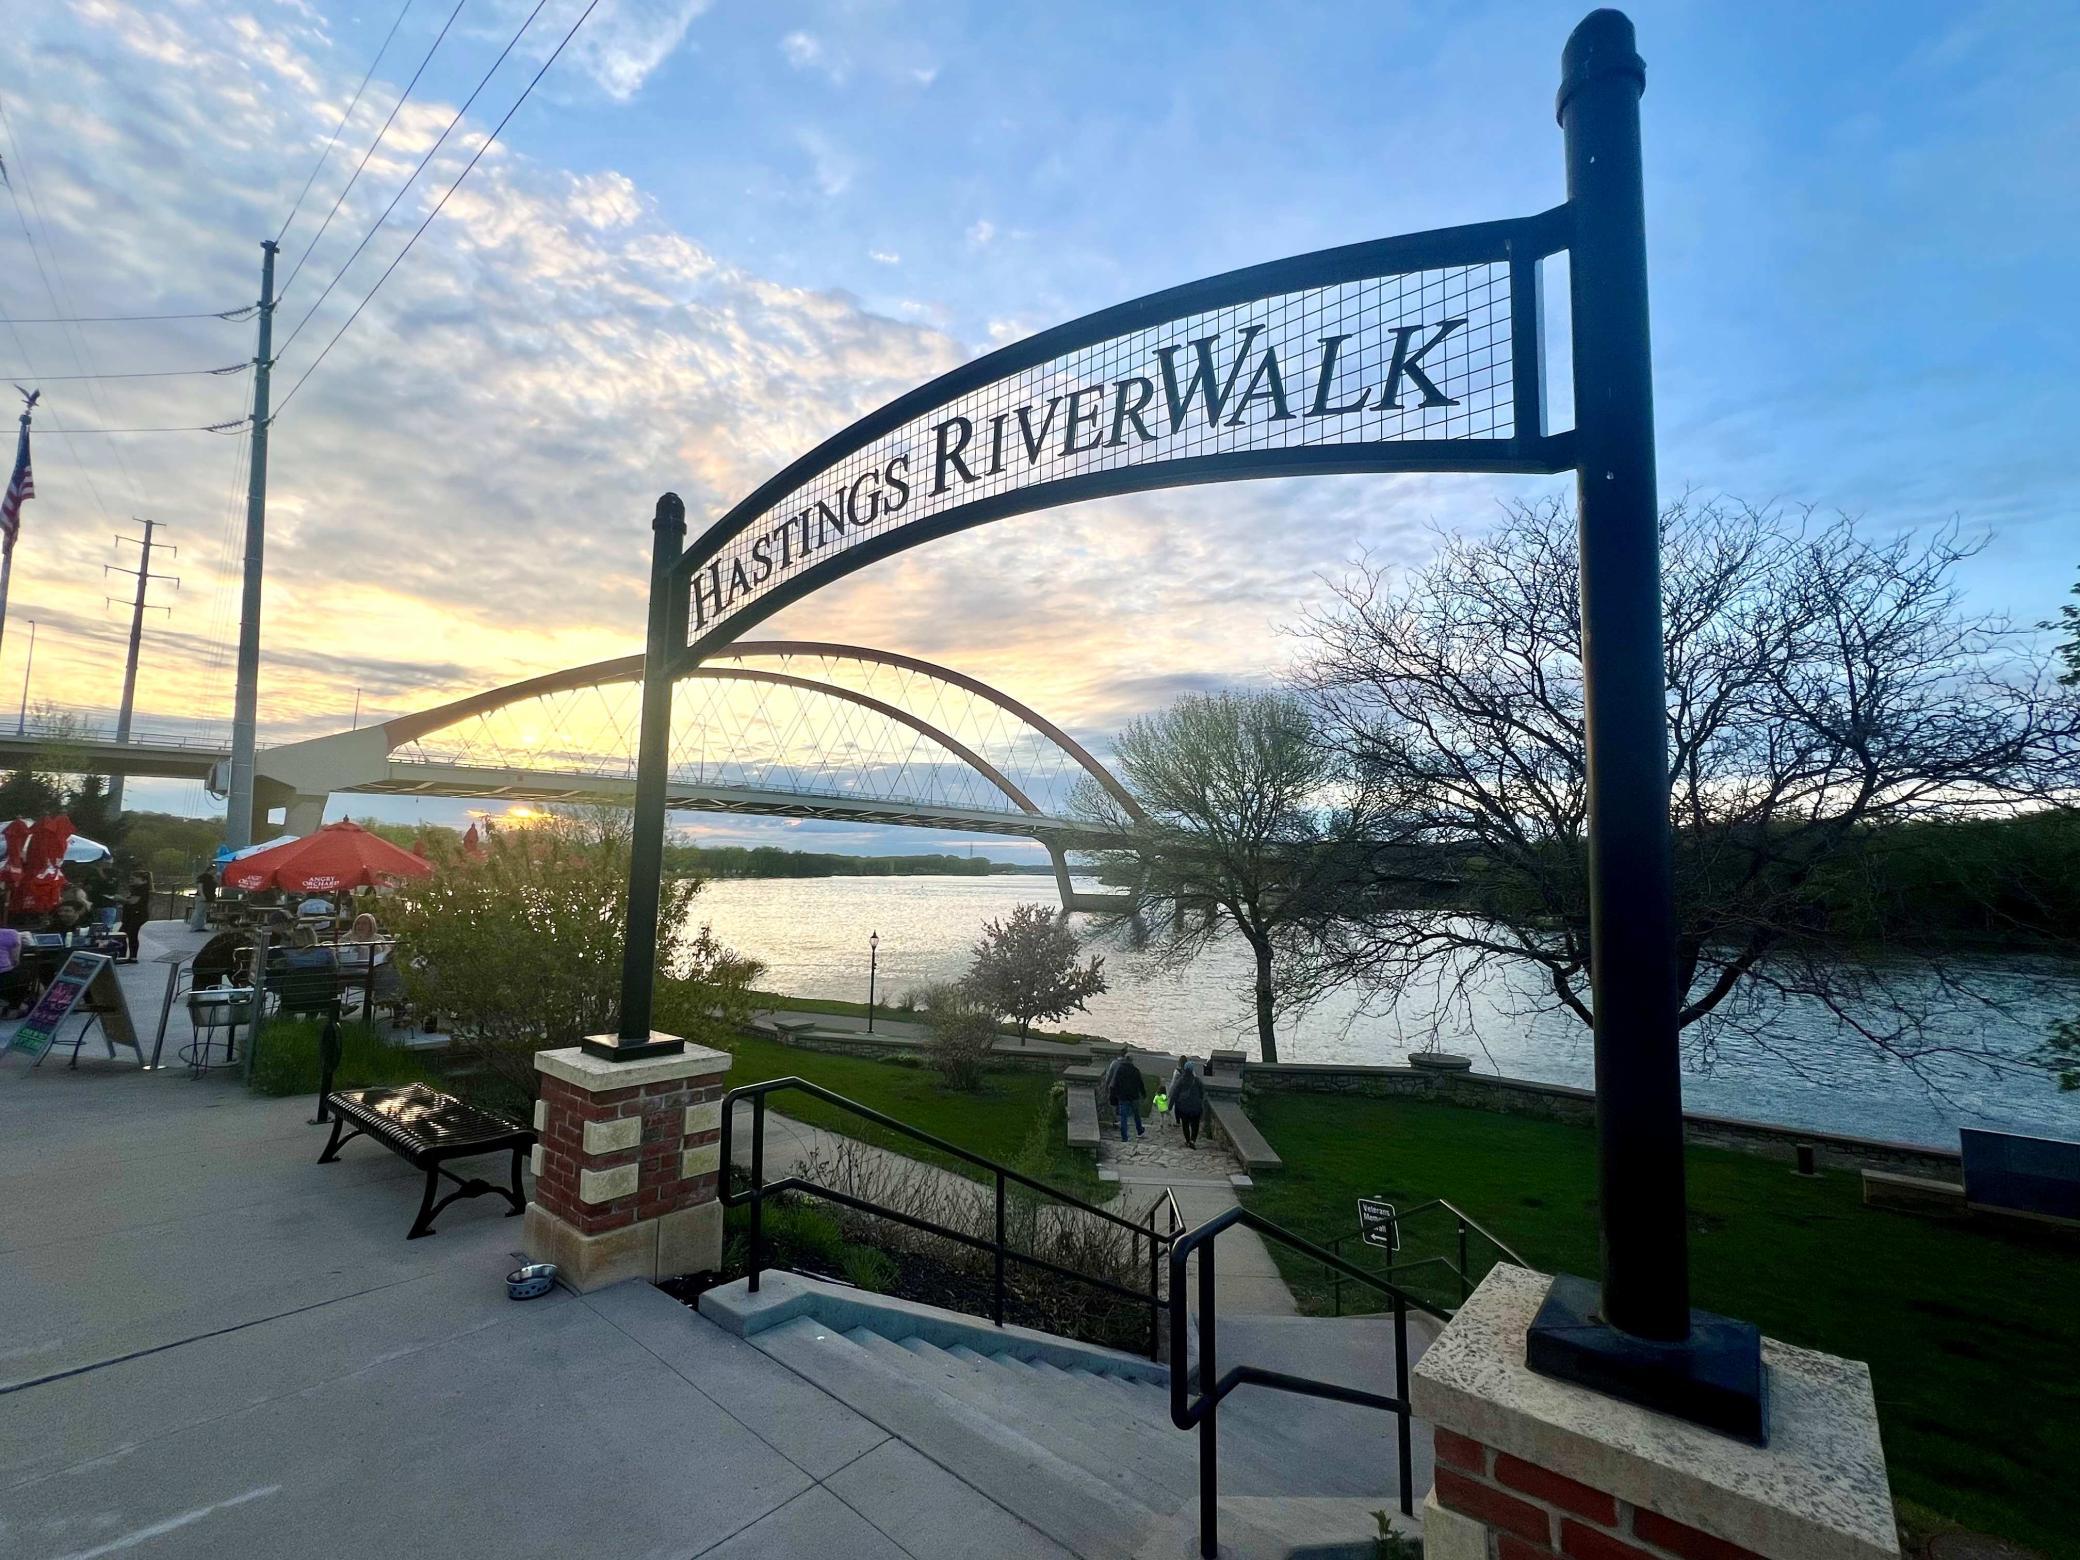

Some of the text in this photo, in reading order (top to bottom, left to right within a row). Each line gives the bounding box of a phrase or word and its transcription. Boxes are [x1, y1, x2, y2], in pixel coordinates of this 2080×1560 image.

[690, 318, 1469, 632] HASTINGS RIVERWALK
[1362, 1203, 1391, 1216] Veterans
